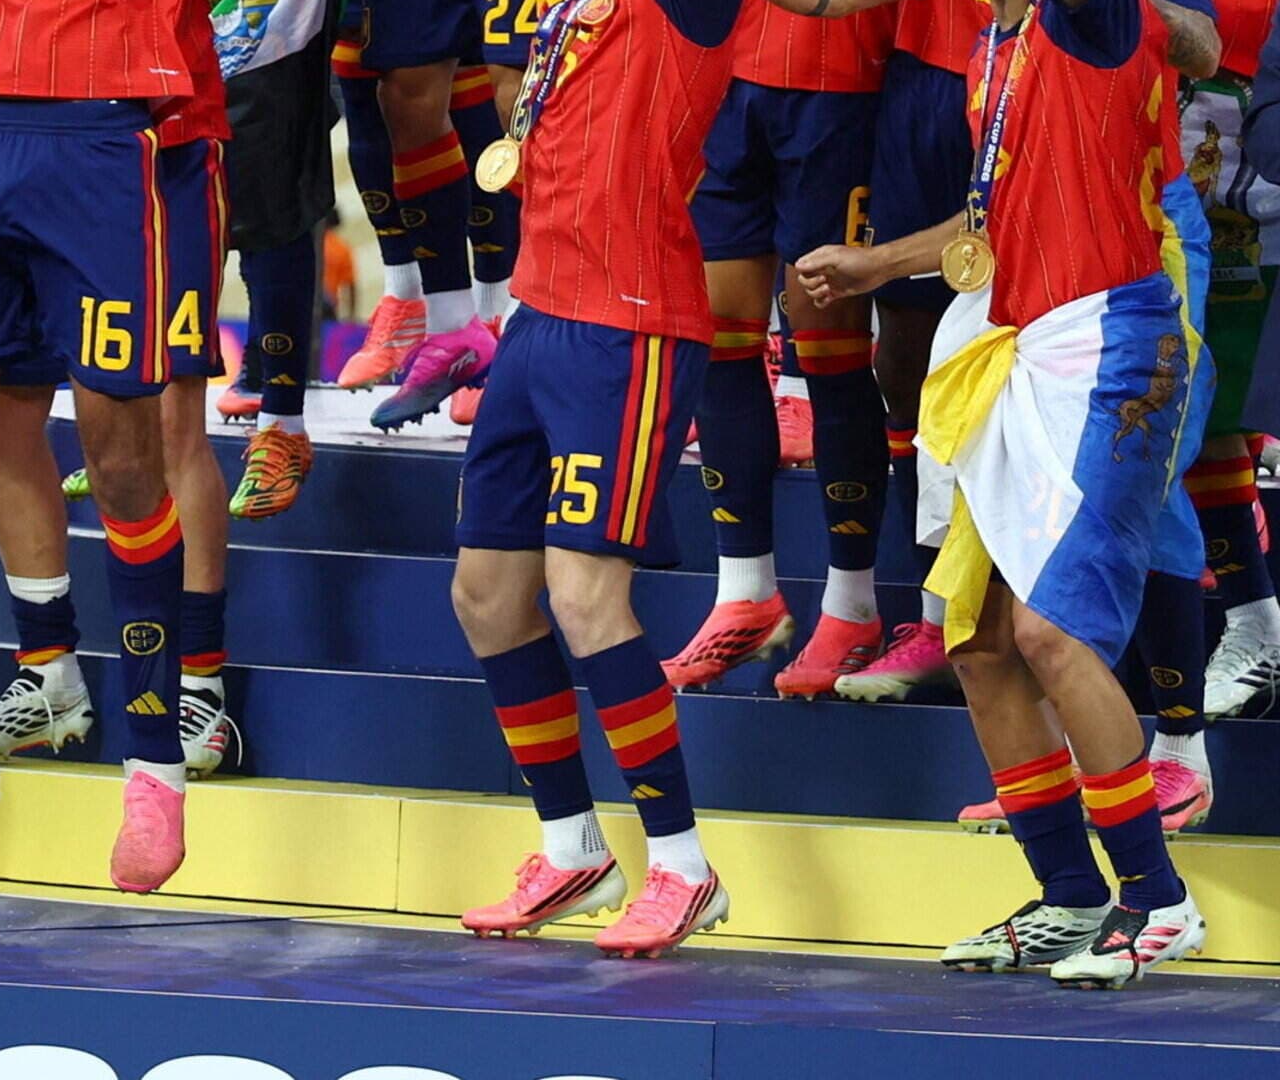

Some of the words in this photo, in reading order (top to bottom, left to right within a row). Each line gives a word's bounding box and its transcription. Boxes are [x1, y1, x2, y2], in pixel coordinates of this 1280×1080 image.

[990, 121, 1002, 144] CUP
[980, 143, 997, 182] 2026
[79, 296, 132, 371] 16
[546, 454, 602, 525] 25
